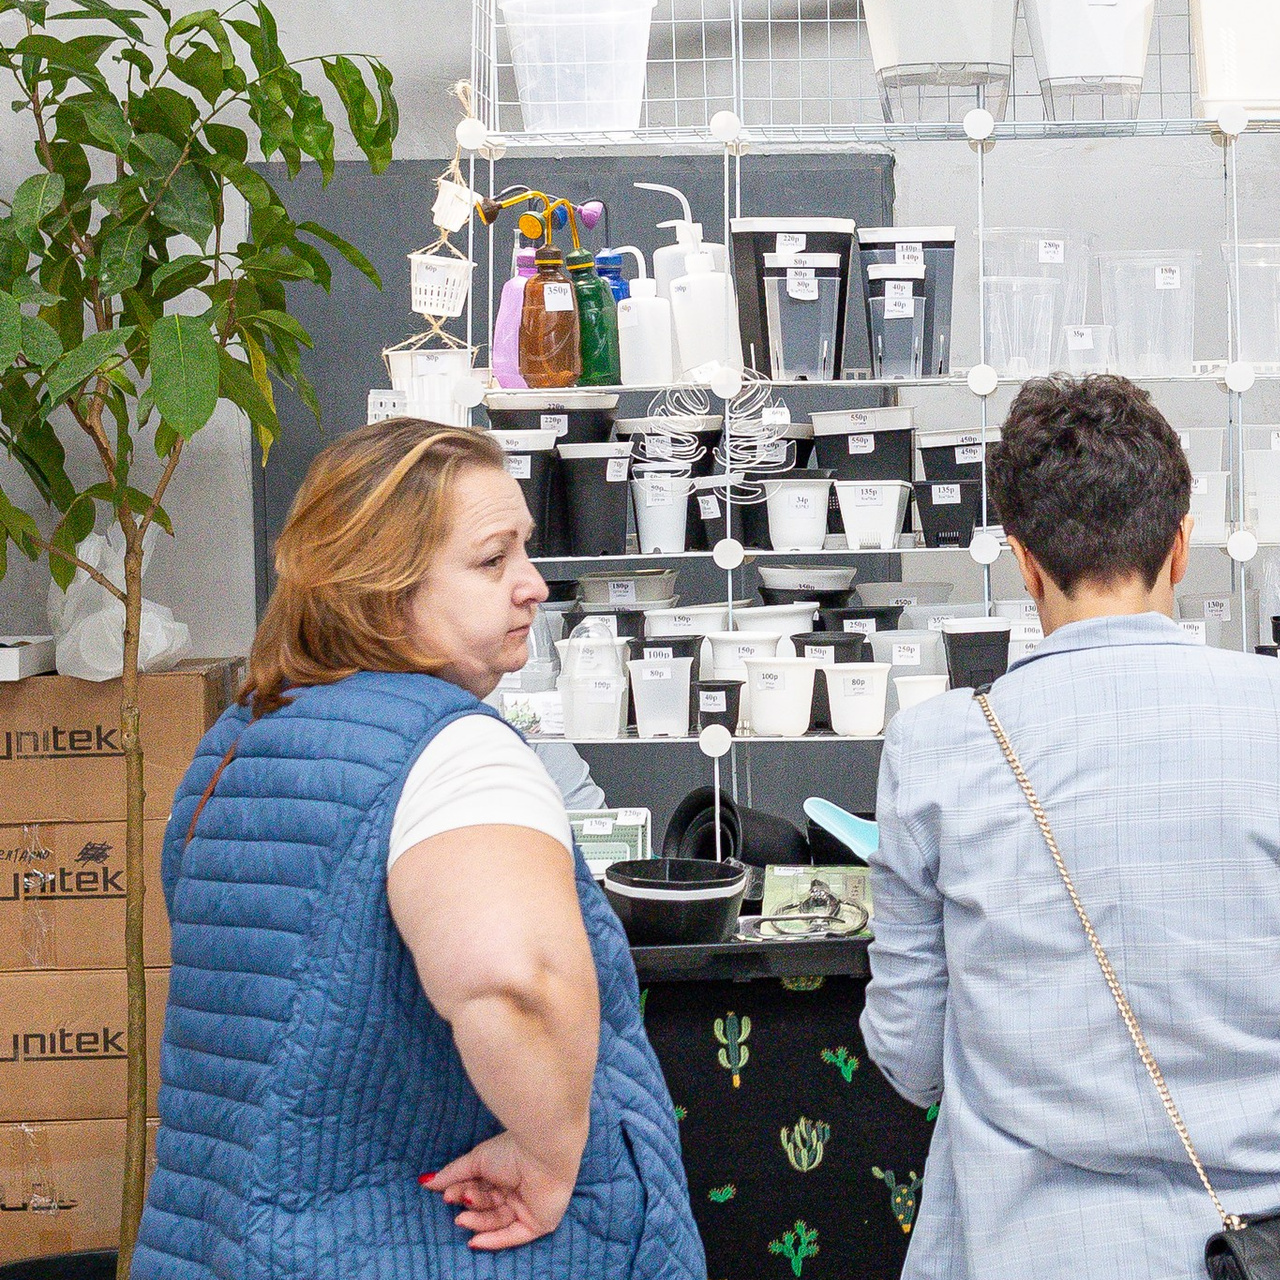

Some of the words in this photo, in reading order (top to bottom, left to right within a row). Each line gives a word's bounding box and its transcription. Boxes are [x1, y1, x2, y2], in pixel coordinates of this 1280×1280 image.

[784, 235, 800, 243] 220р
[425, 265, 438, 273] 60р
[1160, 267, 1176, 275] 180р
[547, 286, 568, 296] 350р
[426, 354, 439, 362] 80р
[851, 414, 867, 422] 550р
[852, 436, 868, 445] 550р
[961, 448, 978, 456] 450р
[613, 461, 624, 469] 70р
[861, 488, 877, 497] 135р
[938, 486, 954, 495] 135р
[796, 496, 808, 504] 34р
[648, 651, 670, 659] 100р
[737, 647, 755, 655] 150р
[810, 648, 827, 656] 150р
[650, 670, 664, 678] 80р
[762, 673, 778, 681] 100р
[705, 694, 717, 702] 40р
